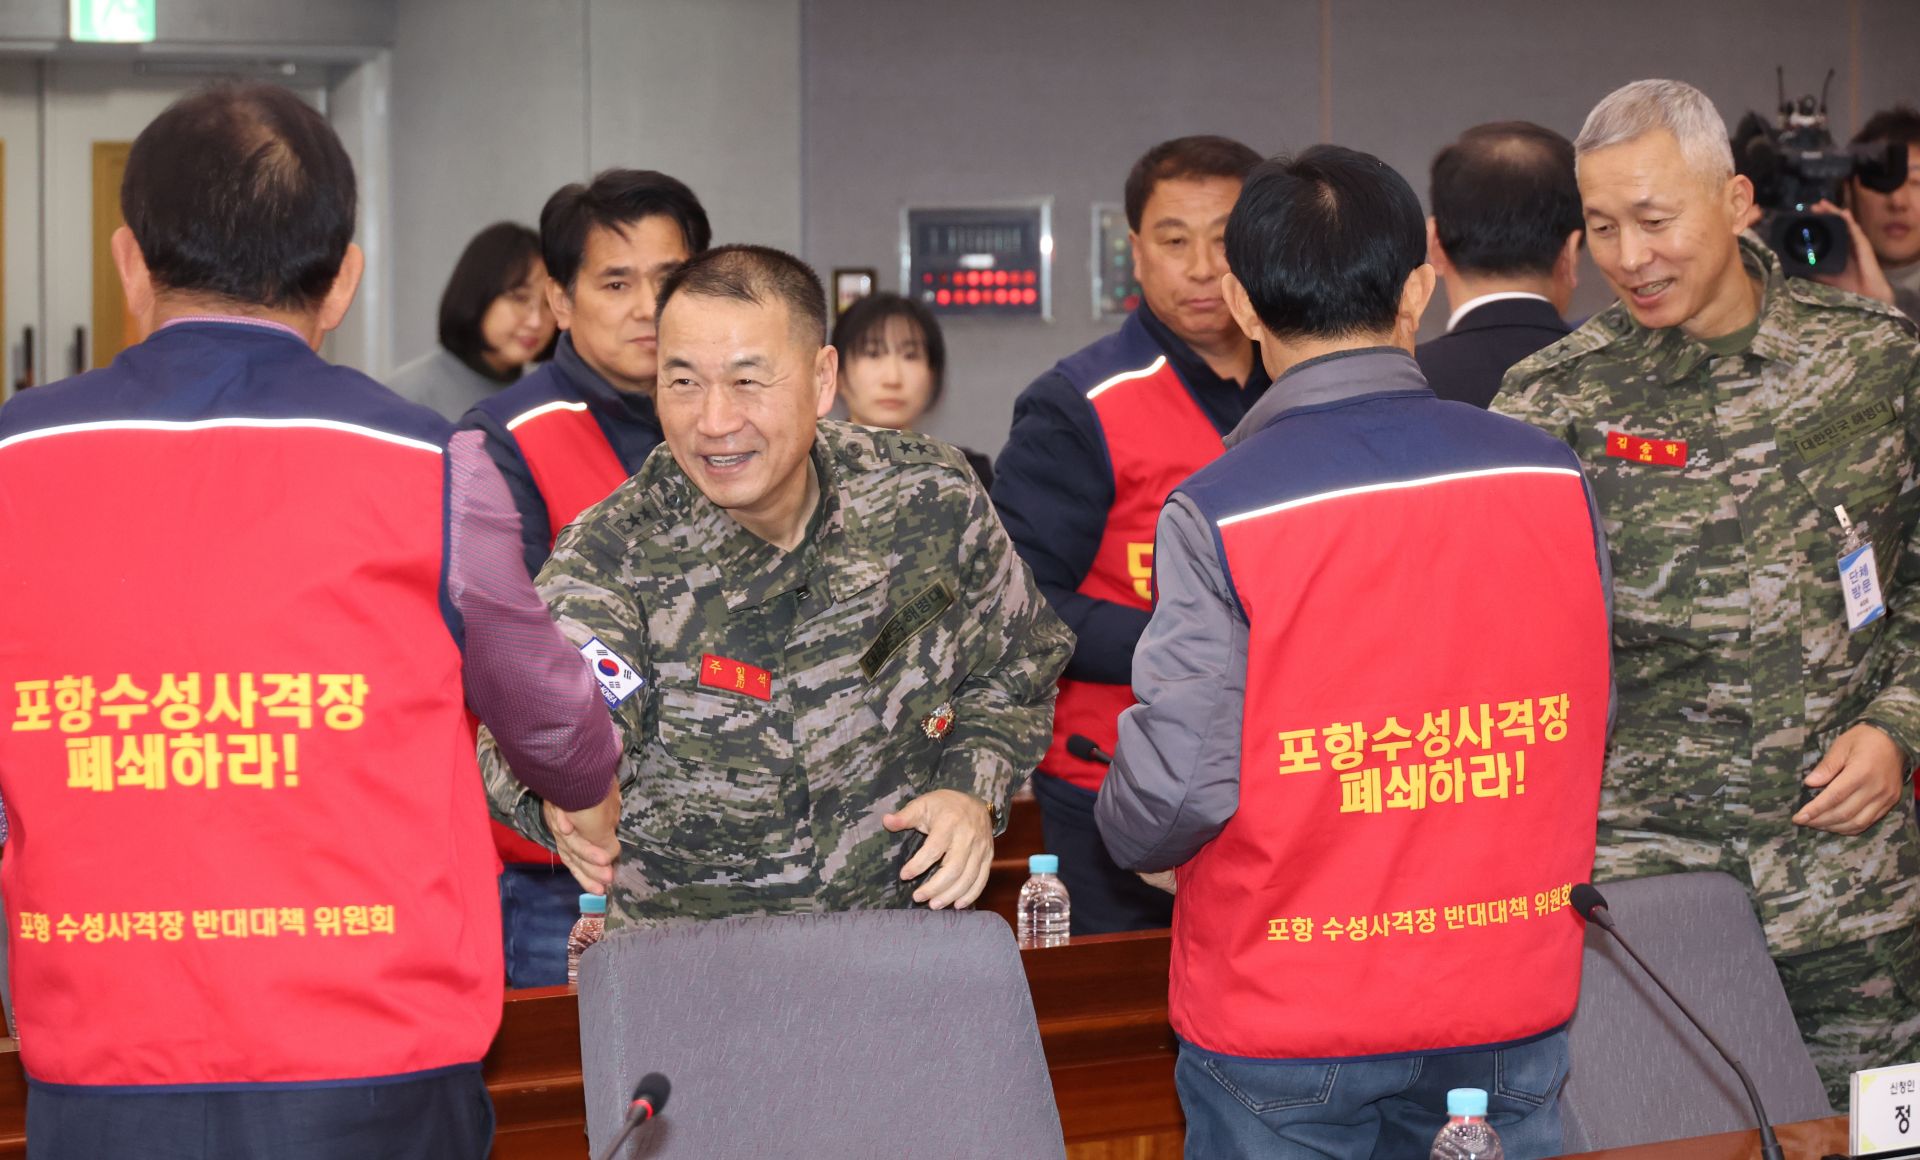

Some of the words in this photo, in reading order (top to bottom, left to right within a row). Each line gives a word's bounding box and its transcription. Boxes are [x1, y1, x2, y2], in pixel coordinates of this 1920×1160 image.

[1848, 562, 1869, 585] 단체
[1851, 578, 1872, 600] 방문
[902, 585, 946, 623] 해병대
[11, 672, 369, 732] 포항수성사격장
[1278, 693, 1570, 775] 포항수성사격장
[65, 733, 299, 791] 폐쇄하라!
[1340, 751, 1525, 813] 폐쇄하라!
[20, 912, 50, 943] 포항
[56, 911, 185, 943] 수성사격장
[192, 907, 306, 940] 반대대책
[313, 905, 395, 936] 위원회
[1267, 917, 1314, 943] 포항
[1322, 909, 1437, 942] 수성사격장
[1444, 896, 1529, 930] 반대대책
[1895, 1104, 1911, 1134] 정
